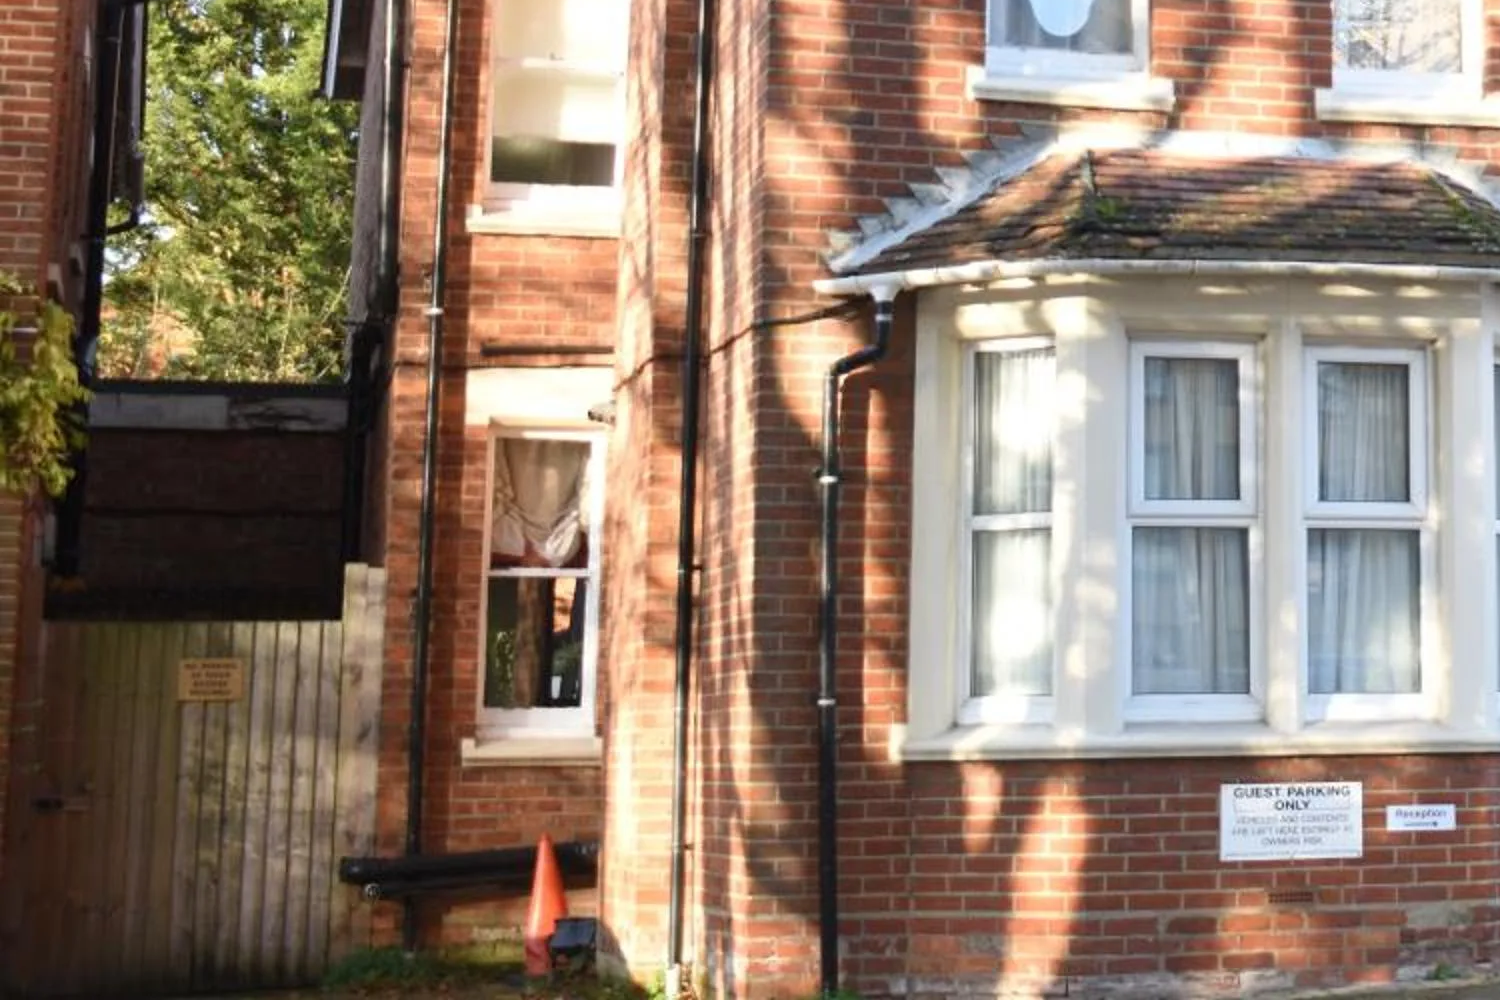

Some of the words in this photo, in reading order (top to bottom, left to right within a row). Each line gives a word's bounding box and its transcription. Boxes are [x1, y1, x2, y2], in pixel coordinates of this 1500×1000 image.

[1233, 787, 1281, 799] GUEST
[1287, 785, 1351, 798] PARKING
[1274, 799, 1311, 811] ONLY
[1394, 807, 1448, 820] Reception
